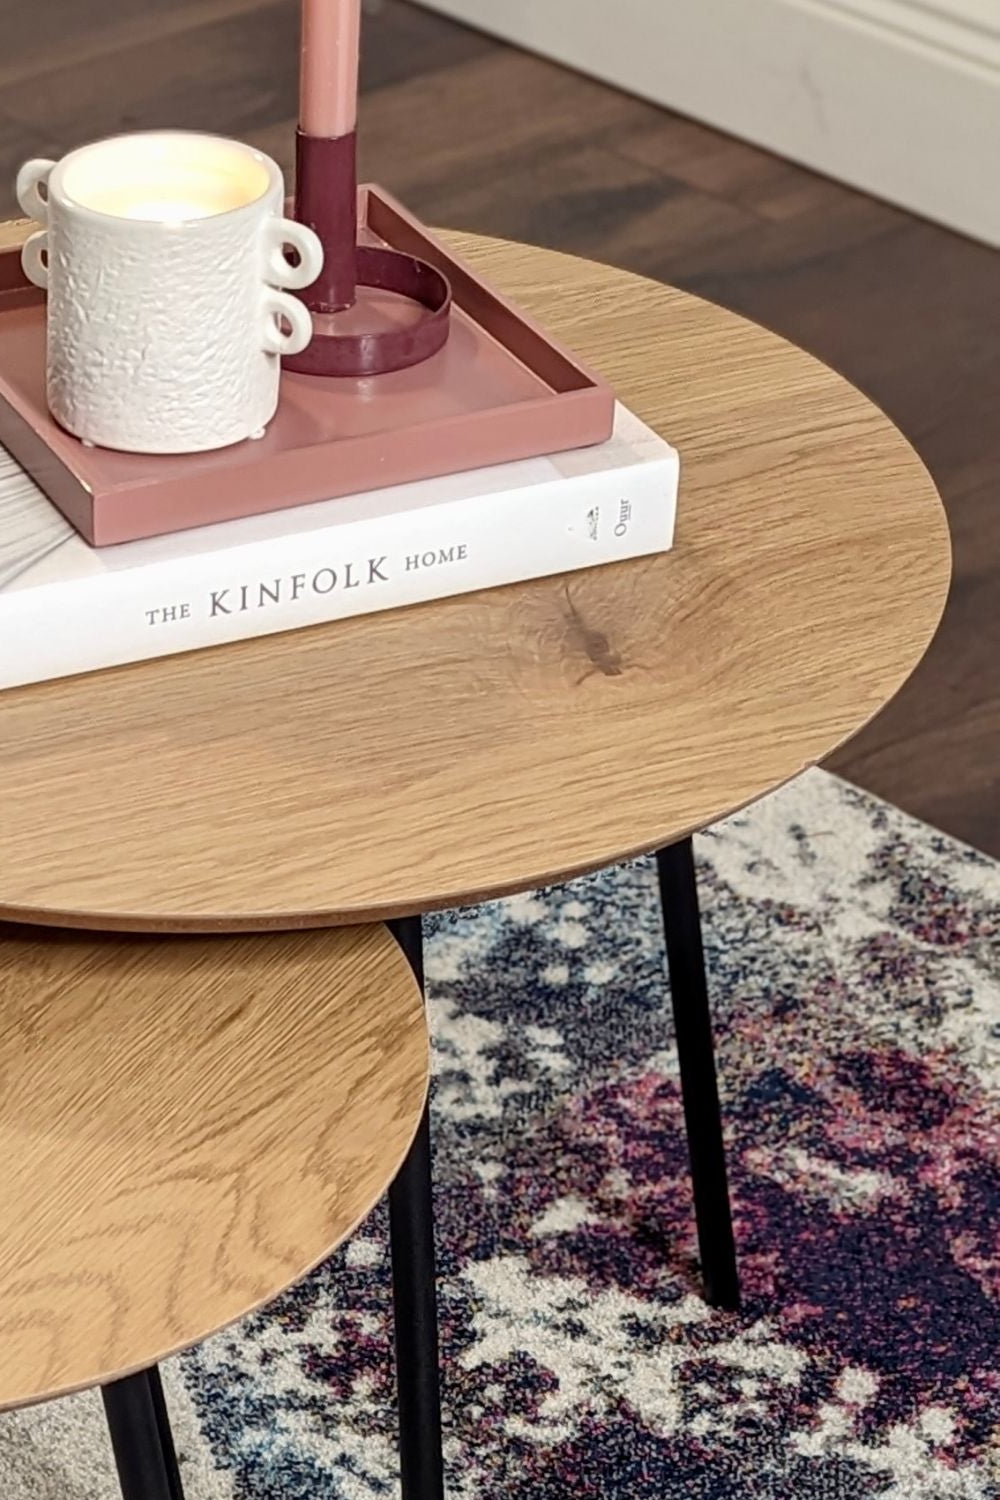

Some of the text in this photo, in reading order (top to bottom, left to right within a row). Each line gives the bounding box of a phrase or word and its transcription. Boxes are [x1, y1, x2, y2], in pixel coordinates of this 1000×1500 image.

[145, 544, 469, 626] THE KINFOLK HOME
